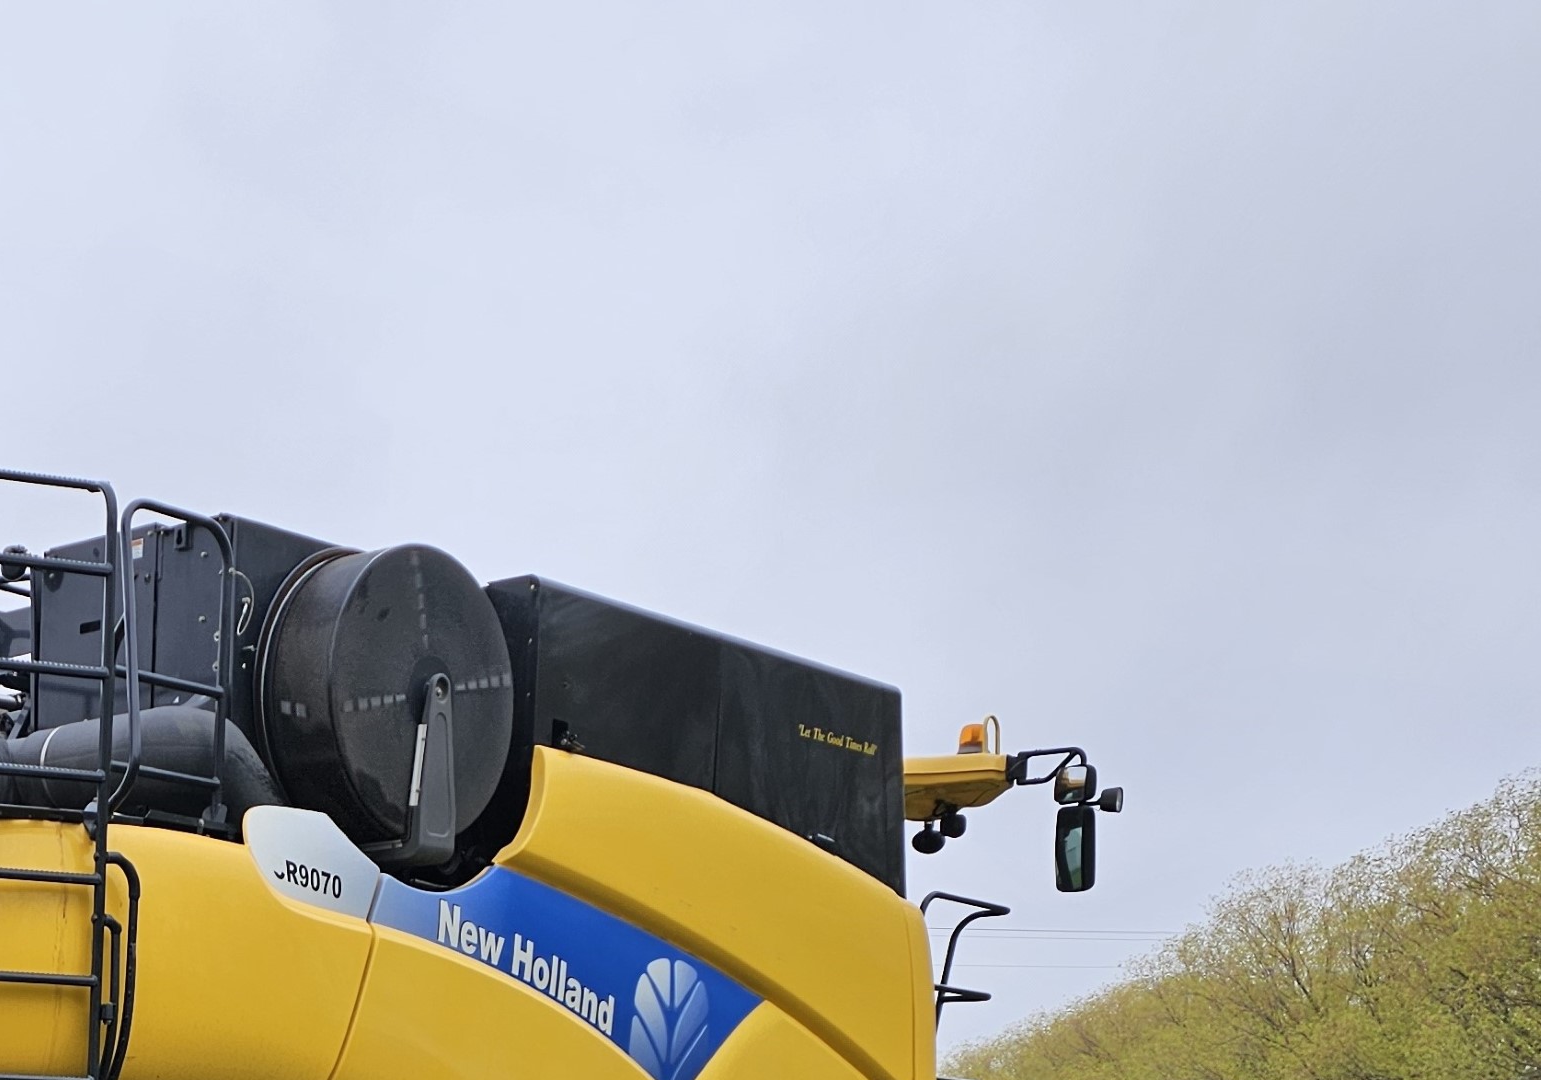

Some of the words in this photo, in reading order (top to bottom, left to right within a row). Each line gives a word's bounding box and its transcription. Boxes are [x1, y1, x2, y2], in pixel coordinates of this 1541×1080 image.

[827, 732, 844, 747] Good
[437, 899, 505, 966] New
[511, 933, 615, 1036] Holland
